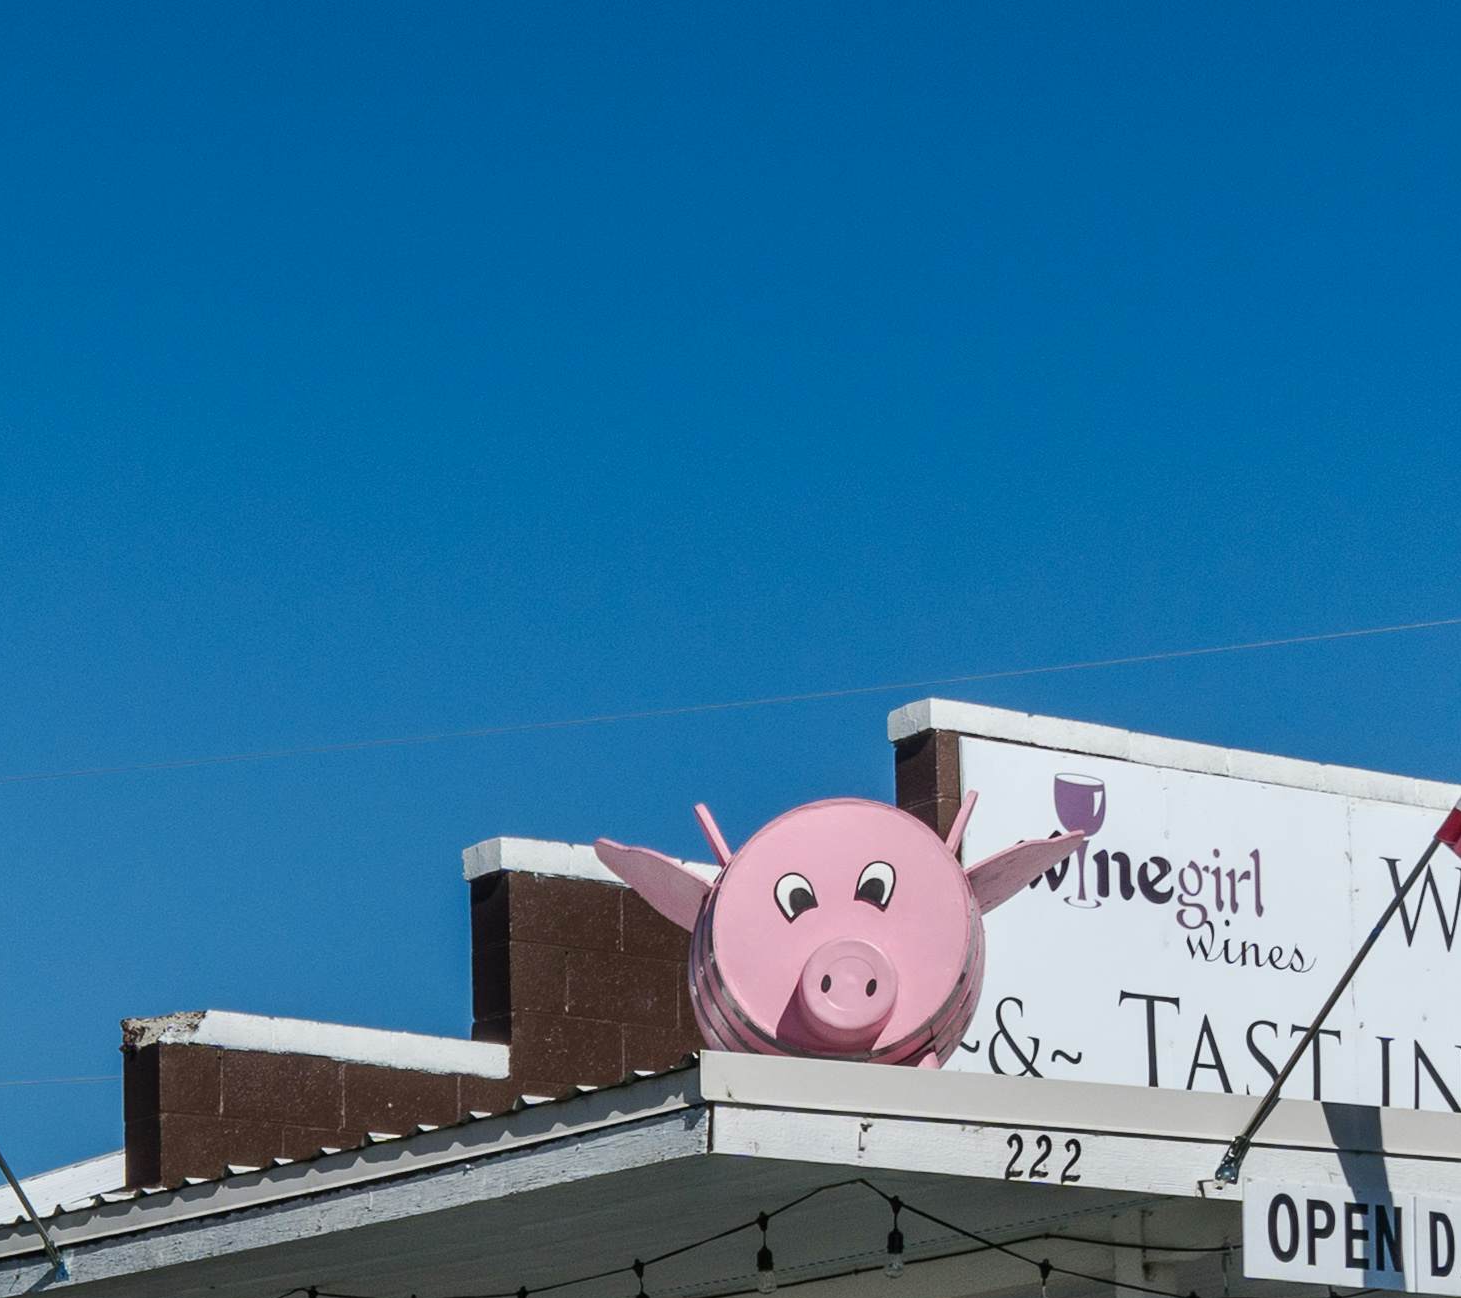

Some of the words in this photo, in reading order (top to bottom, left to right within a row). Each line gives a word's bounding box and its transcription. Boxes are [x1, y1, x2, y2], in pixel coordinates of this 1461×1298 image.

[1187, 919, 1317, 973] wines
[1006, 1134, 1082, 1184] 222
[1267, 1193, 1403, 1273] OPEN
